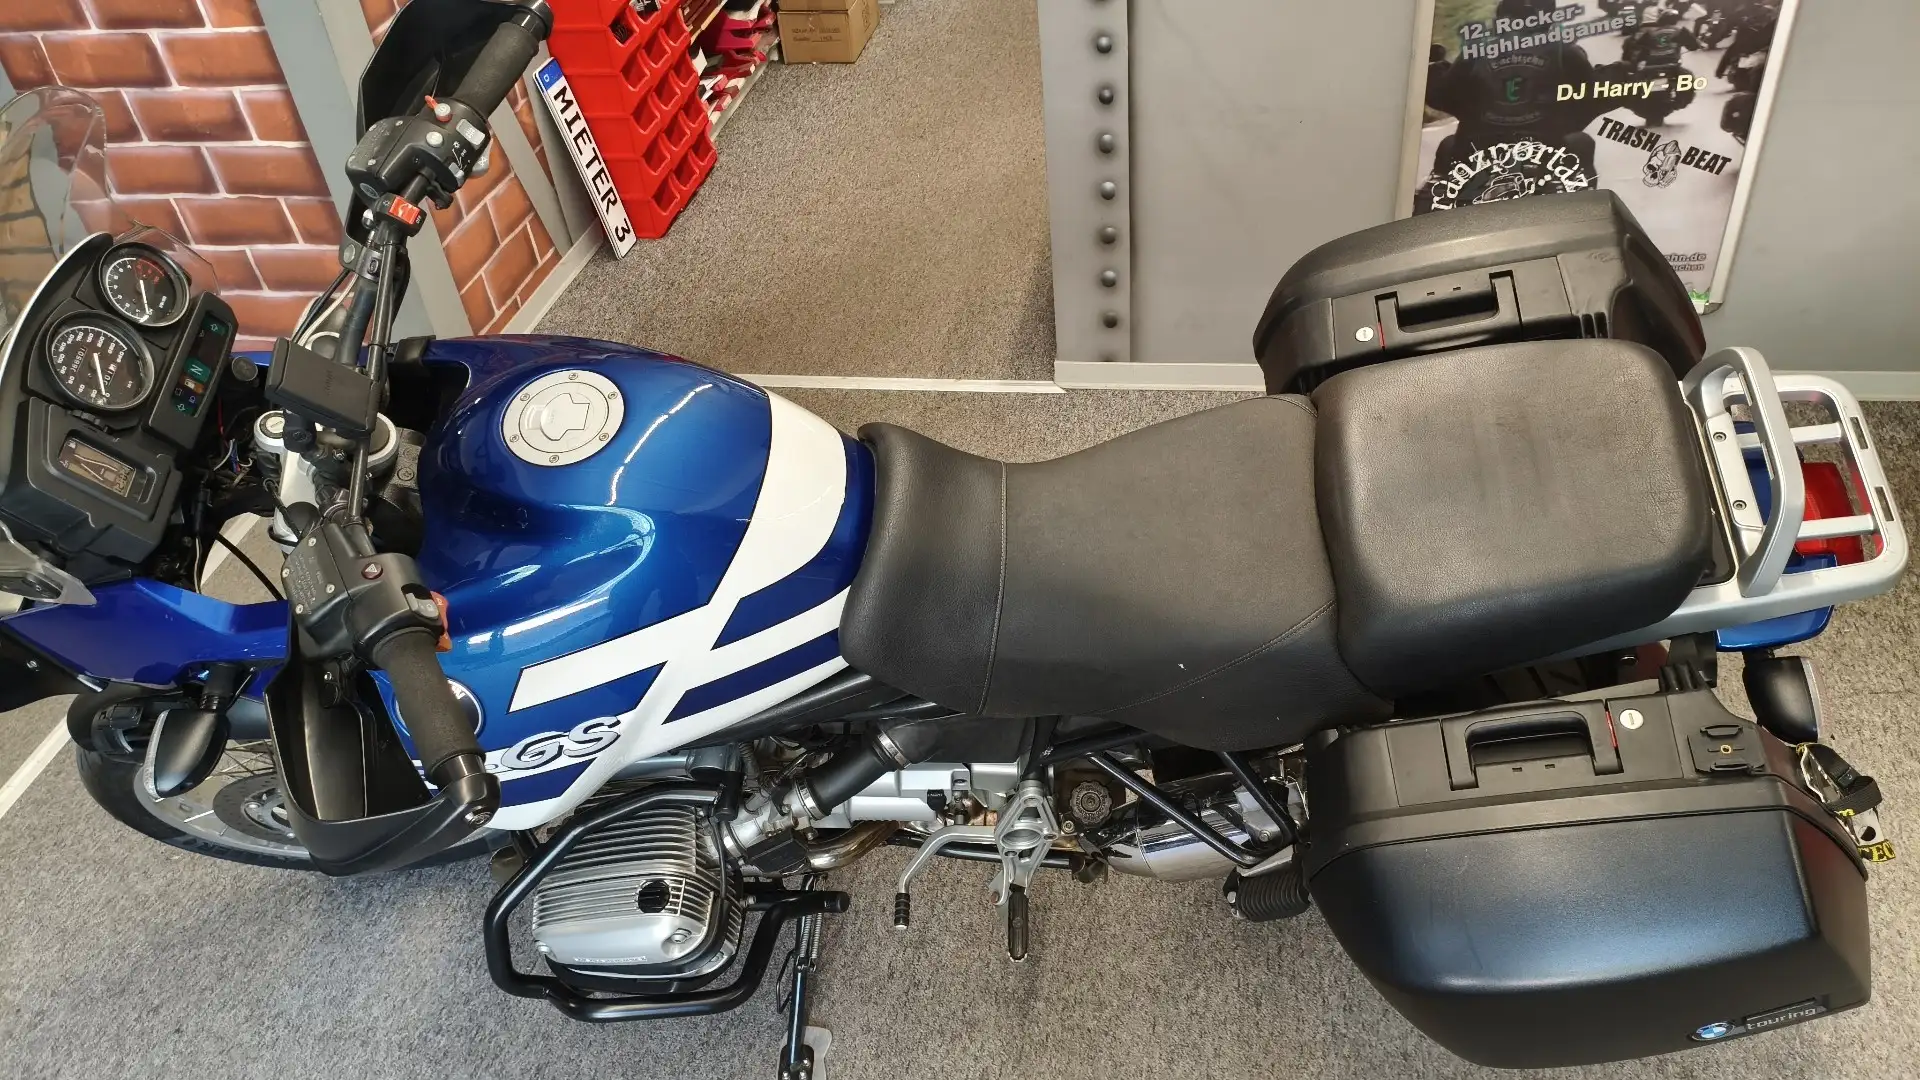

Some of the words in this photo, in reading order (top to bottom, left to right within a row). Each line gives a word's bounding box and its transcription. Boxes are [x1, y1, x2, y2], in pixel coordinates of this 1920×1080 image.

[1459, 23, 1491, 41] 12.
[1496, 7, 1584, 35] Rocker-
[1462, 14, 1637, 60] Highlandgames
[1557, 83, 1586, 101] DJ
[1592, 80, 1655, 100] Harry
[1676, 74, 1708, 92] Bo
[1596, 117, 1662, 153] TRASH
[553, 85, 618, 215] MIETER
[614, 218, 632, 243] 3
[1680, 146, 1732, 176] BEAT
[189, 364, 203, 376] N
[501, 715, 621, 770] GS
[1746, 1007, 1817, 1030] touring
